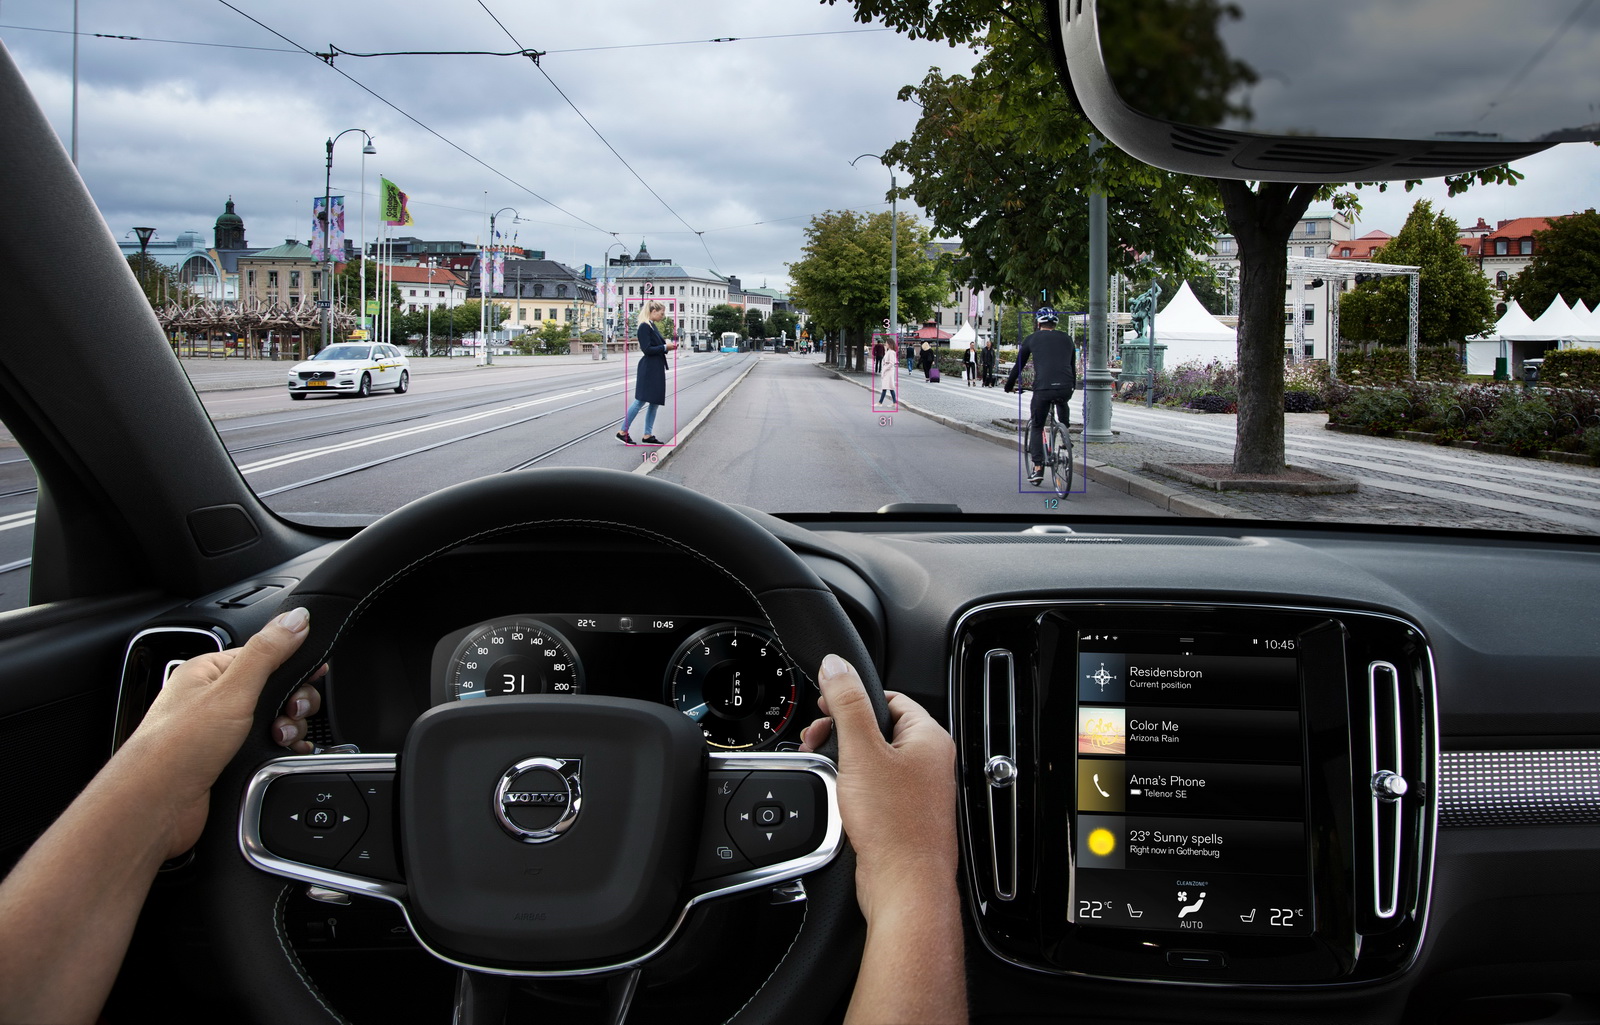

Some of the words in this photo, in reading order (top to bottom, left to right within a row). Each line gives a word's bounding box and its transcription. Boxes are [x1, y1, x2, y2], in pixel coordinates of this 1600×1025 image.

[731, 639, 738, 648] 4
[1265, 640, 1294, 649] 10:45
[704, 646, 711, 656] 3
[760, 648, 767, 657] 5
[686, 666, 693, 675] 2
[776, 668, 783, 677] 6
[1130, 667, 1202, 678] Residensbron
[503, 674, 524, 692] 31
[1130, 680, 1158, 688] Current
[1162, 682, 1191, 690] position
[734, 695, 743, 706] D
[779, 696, 786, 705] 7
[763, 721, 770, 730] 8
[1130, 720, 1158, 730] Color
[1162, 721, 1178, 731] Me
[1130, 734, 1159, 742] Arizona
[1130, 775, 1166, 785] Anna's
[1171, 776, 1205, 787] Phone
[508, 793, 566, 803] VOLVO
[1144, 789, 1173, 797] Telenor
[1176, 790, 1187, 798] SE
[1154, 831, 1188, 845] Sunny
[1192, 834, 1223, 846] spells
[1130, 845, 1149, 855] Right
[1176, 847, 1219, 858] Gothenburg
[513, 912, 547, 922] AIRBAG
[1180, 921, 1203, 929] AUTO
